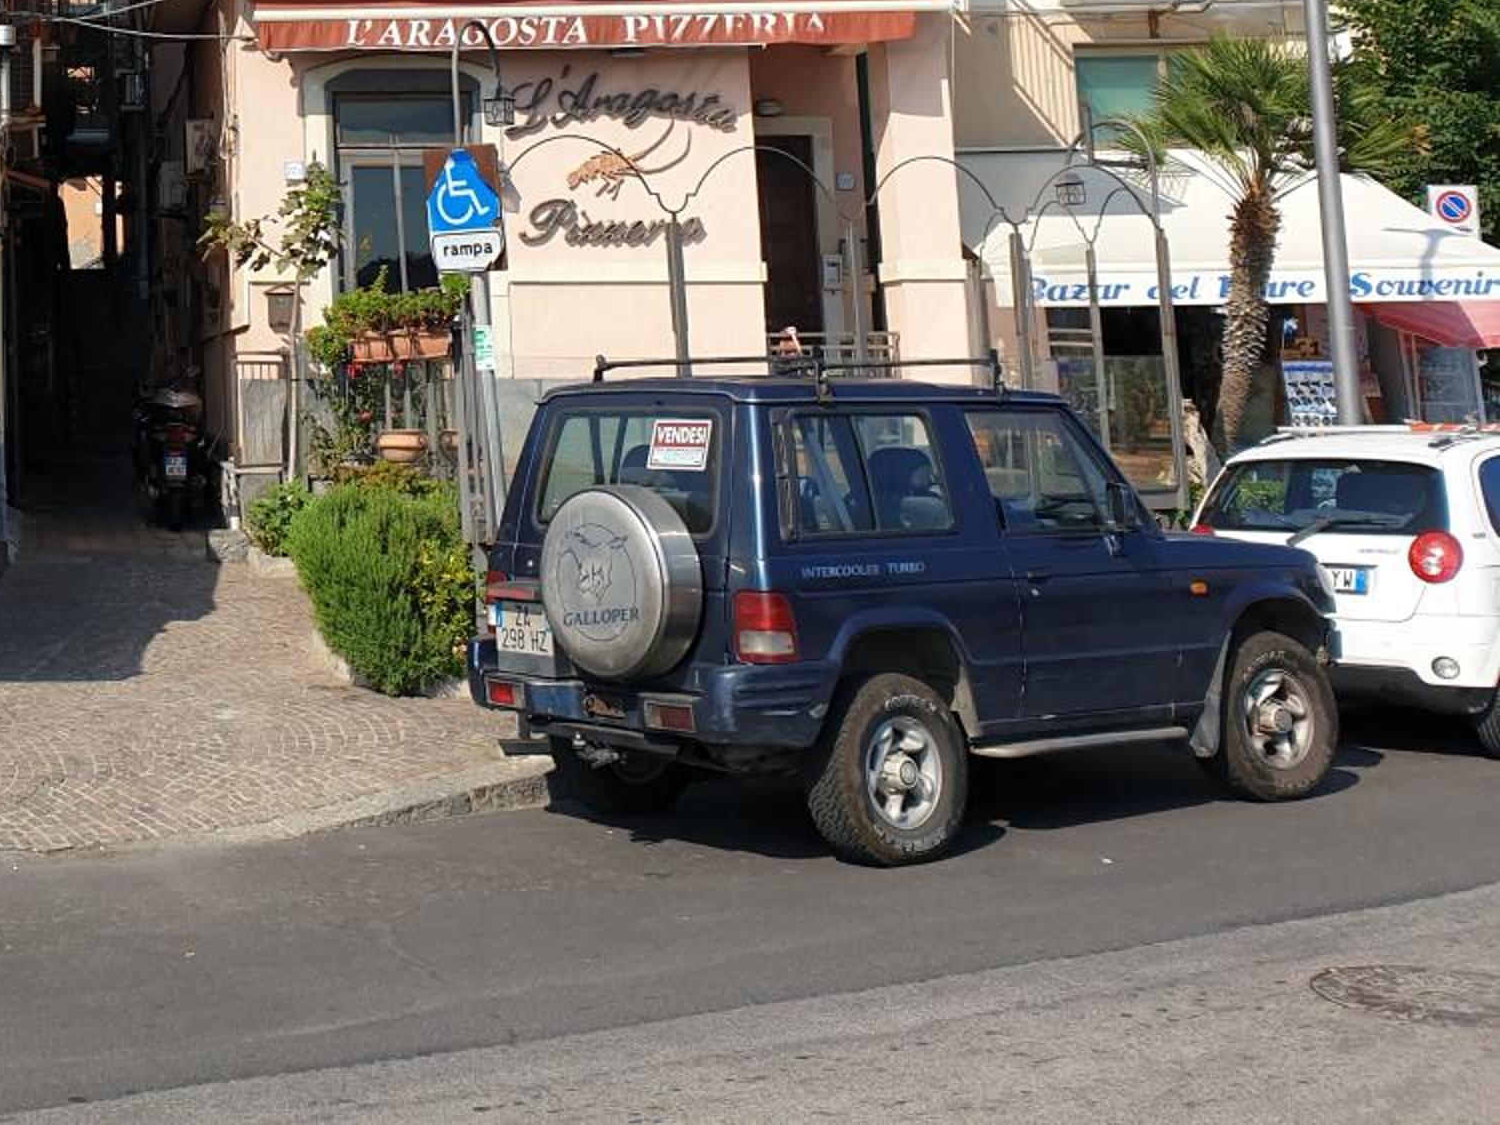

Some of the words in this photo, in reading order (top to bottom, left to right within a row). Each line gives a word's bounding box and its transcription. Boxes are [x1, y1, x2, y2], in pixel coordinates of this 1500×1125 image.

[443, 241, 493, 257] rampa
[657, 426, 707, 444] VENDESI
[887, 561, 925, 573] TURBO
[563, 607, 640, 626] GALLOPER
